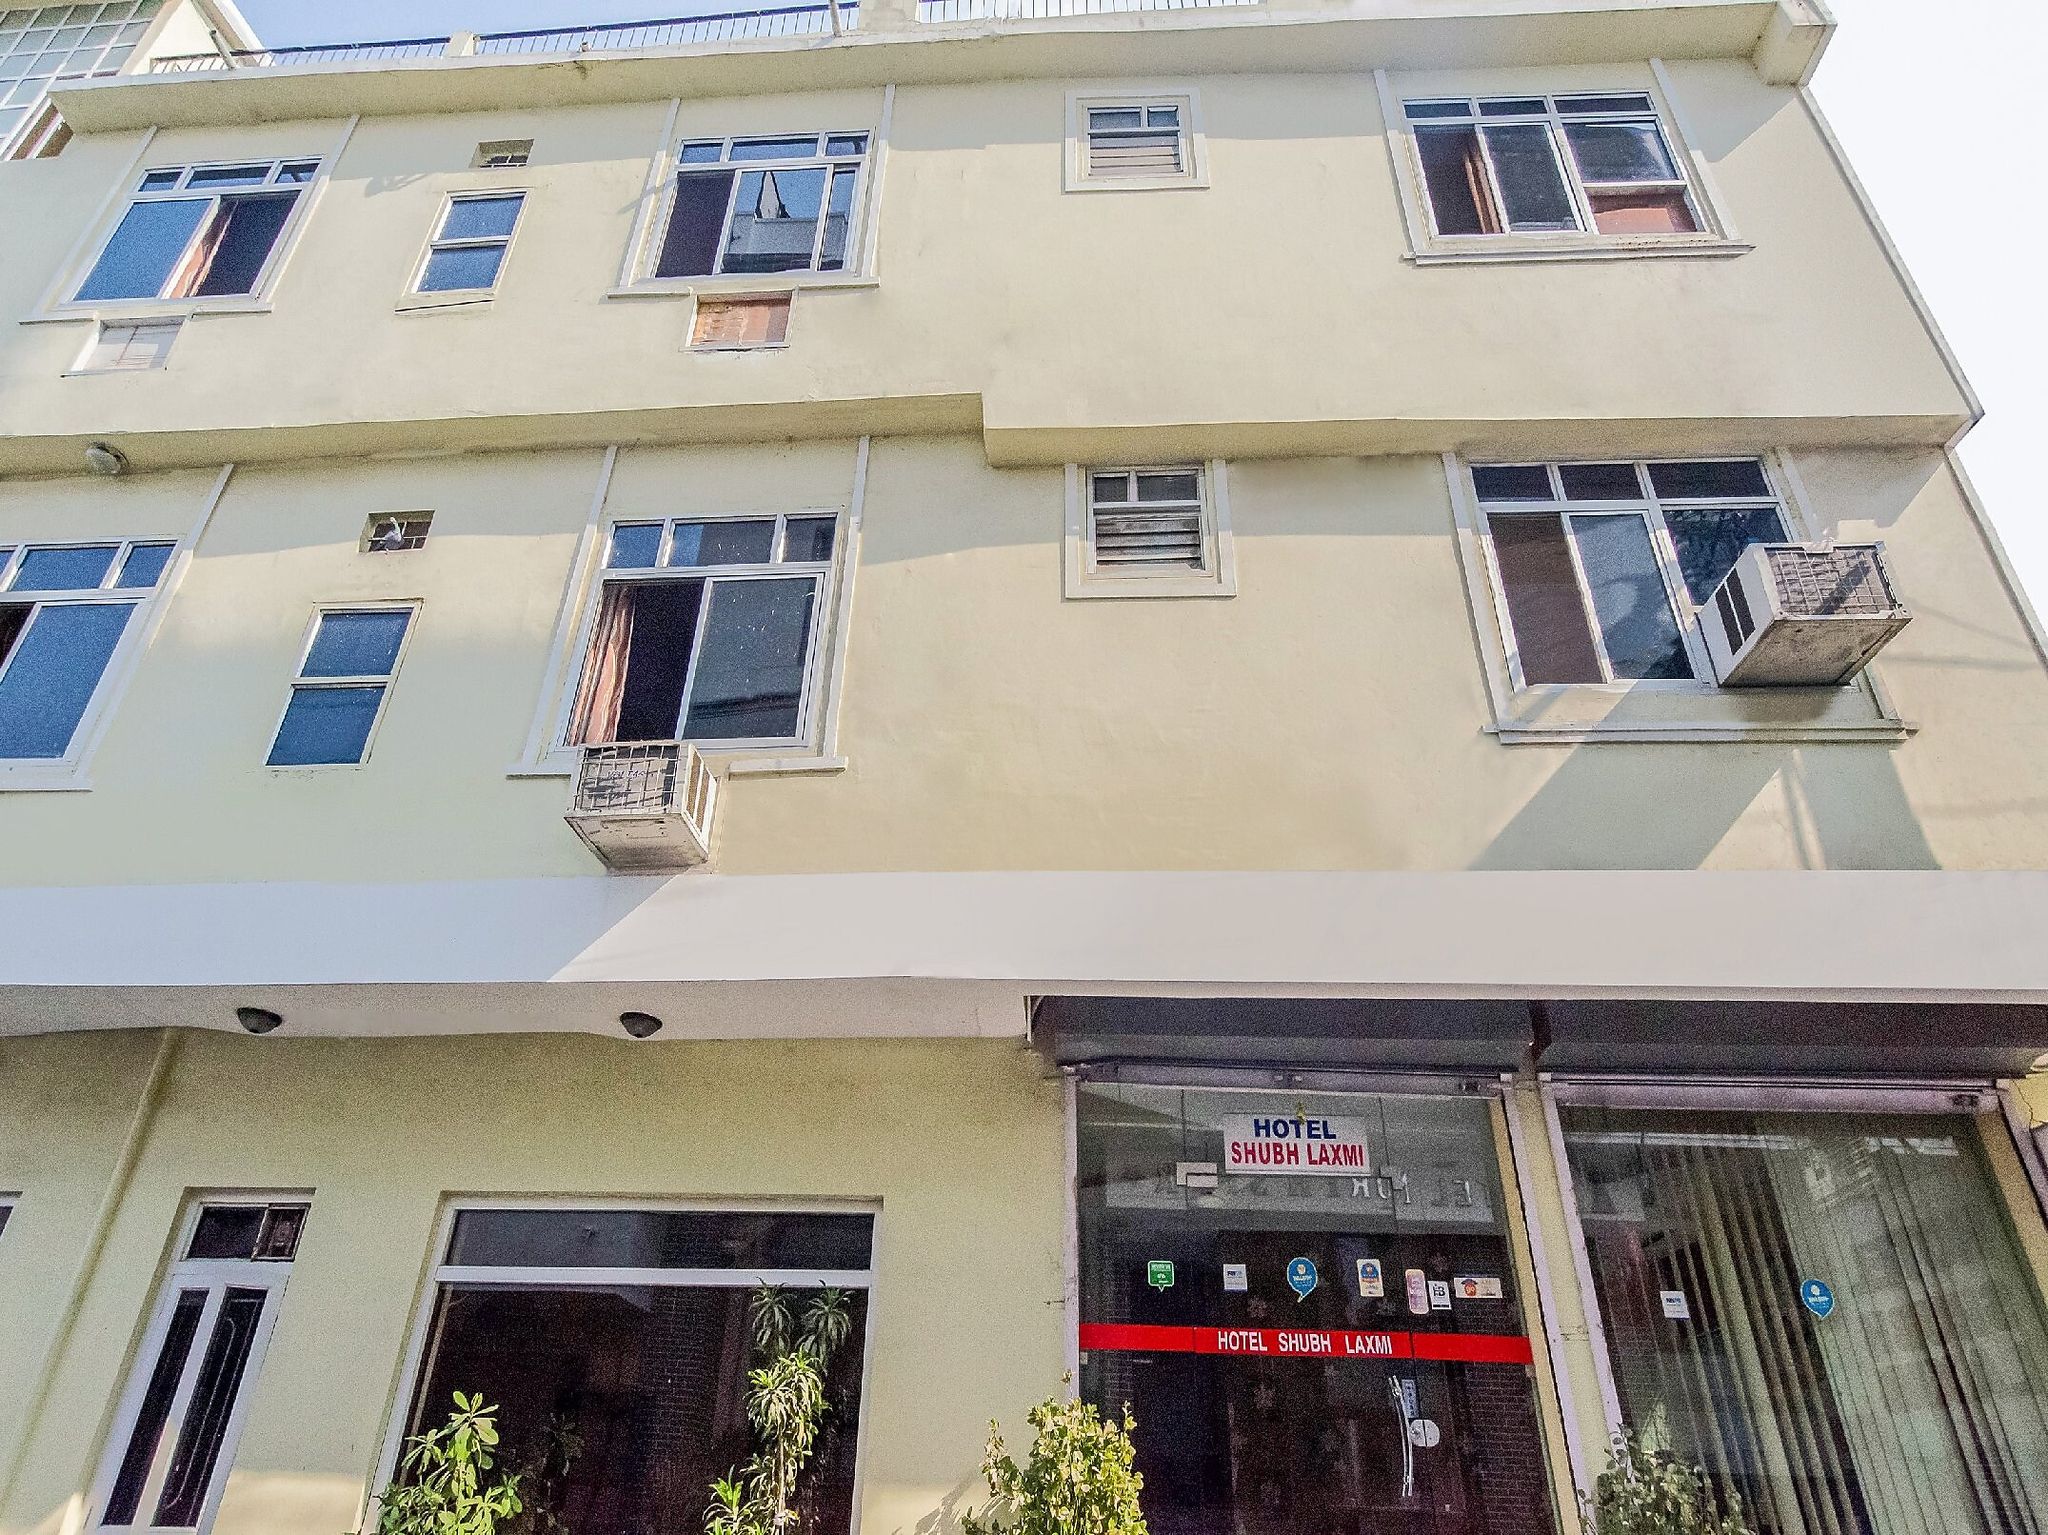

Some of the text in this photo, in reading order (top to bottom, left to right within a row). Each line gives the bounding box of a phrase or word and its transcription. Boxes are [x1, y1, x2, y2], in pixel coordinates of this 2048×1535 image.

[1254, 1118, 1337, 1139] HOTEL
[1231, 1141, 1364, 1167] SHUBH LAXMI
[1218, 1330, 1392, 1354] HOTEL SHUBH LAXMI
